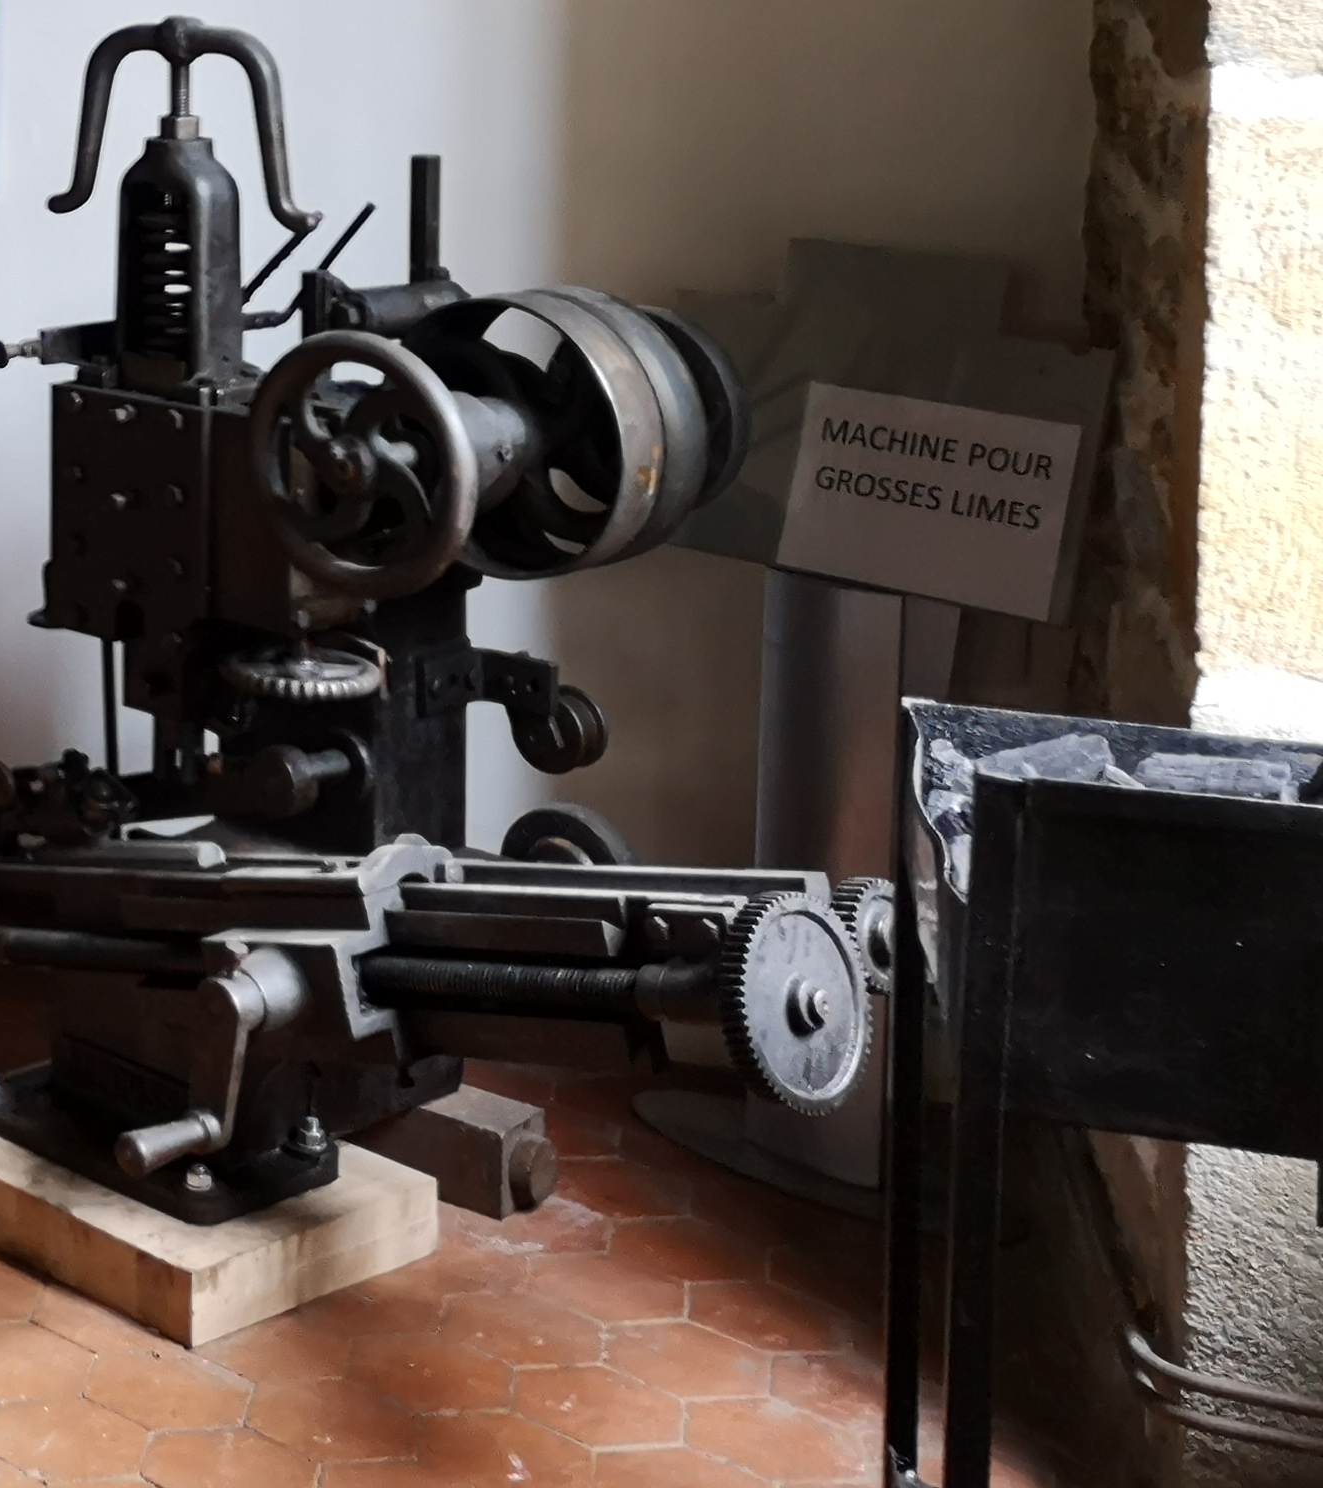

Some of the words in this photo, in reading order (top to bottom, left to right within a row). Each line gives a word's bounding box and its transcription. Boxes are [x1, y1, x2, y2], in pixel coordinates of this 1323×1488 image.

[821, 416, 959, 463] MACHINE
[967, 442, 1052, 480] POUR
[815, 466, 942, 510] GROSSES
[950, 490, 1042, 530] LIMES
